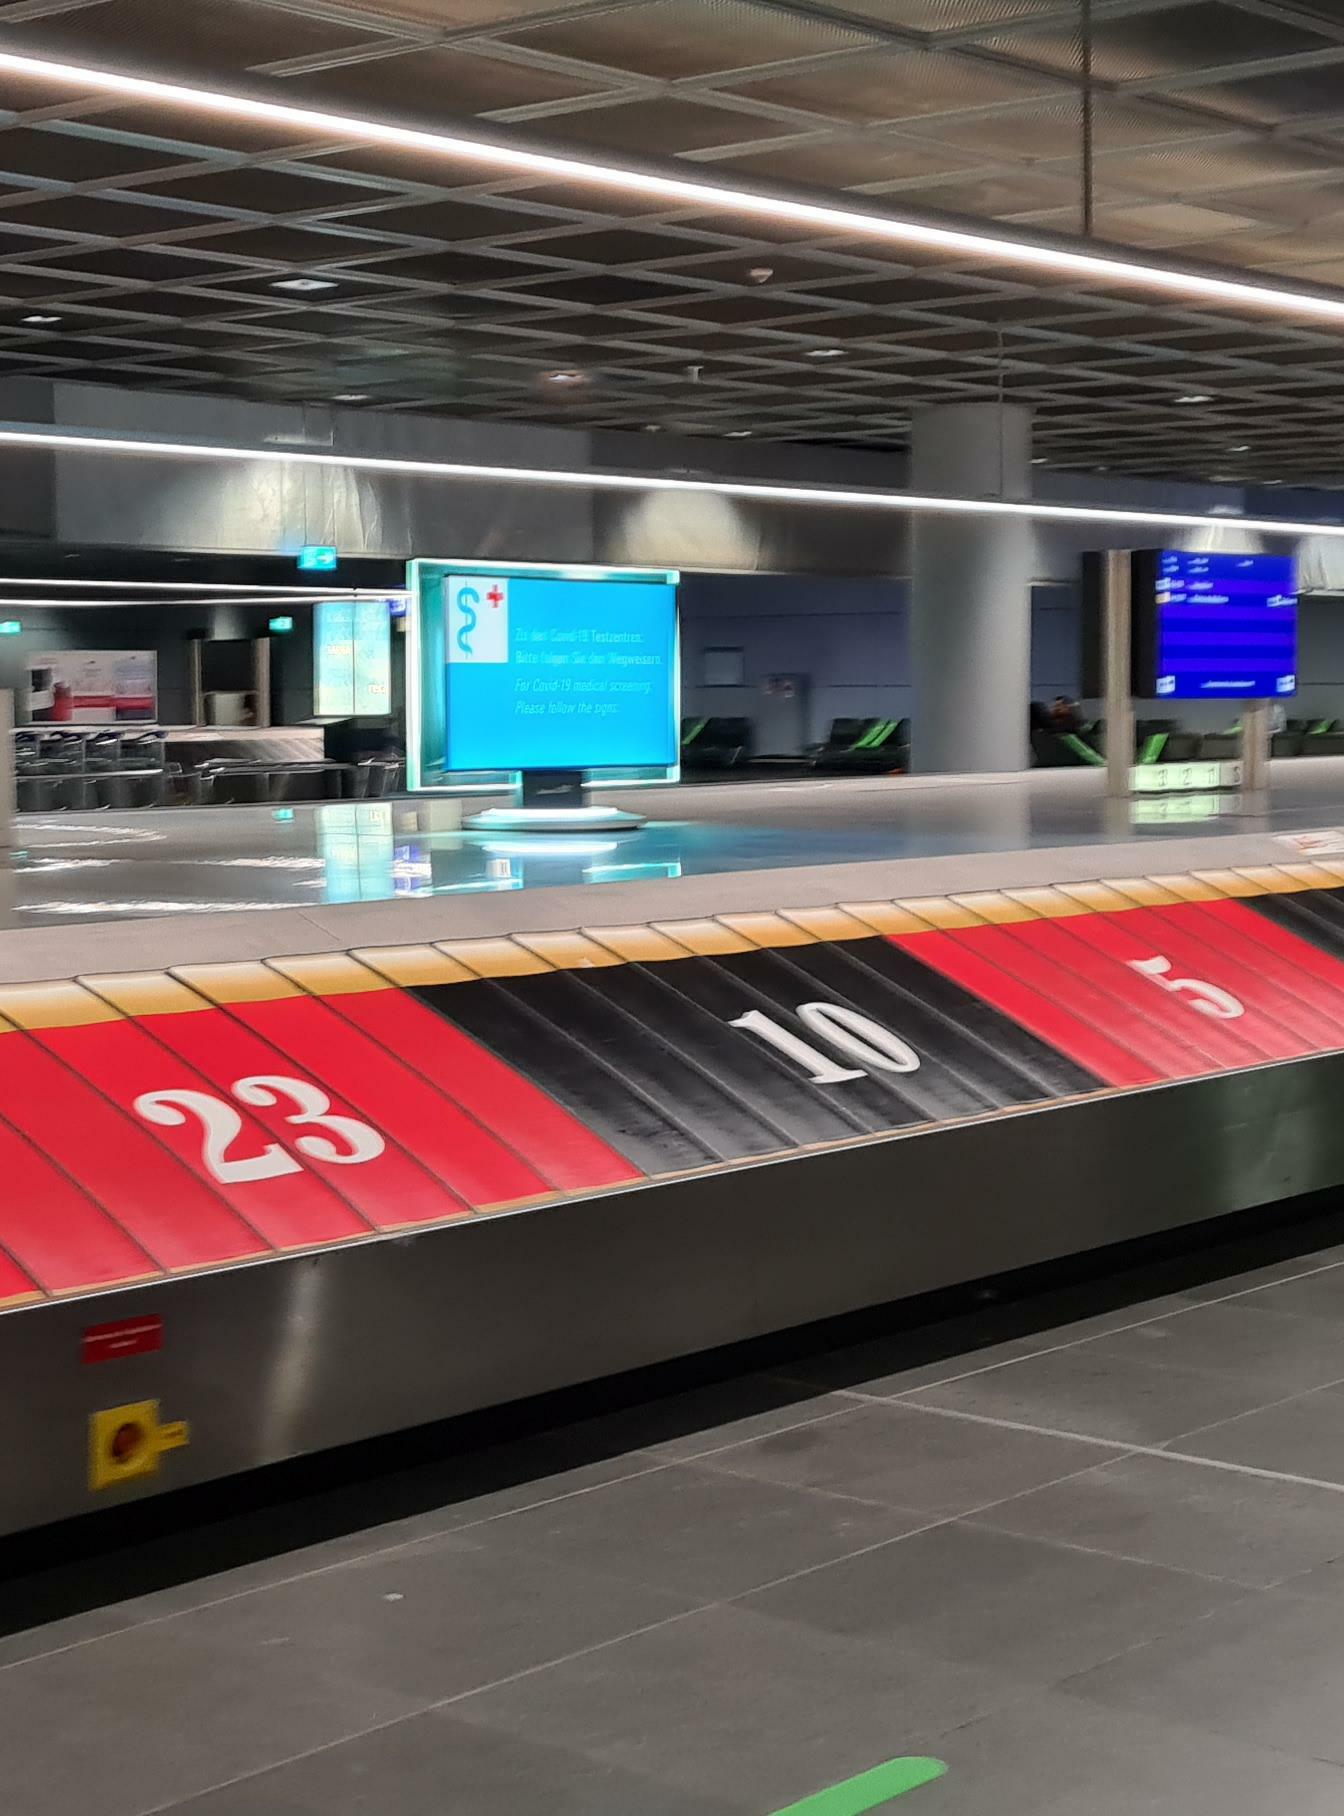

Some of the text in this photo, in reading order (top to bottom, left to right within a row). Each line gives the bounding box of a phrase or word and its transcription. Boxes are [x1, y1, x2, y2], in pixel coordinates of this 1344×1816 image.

[514, 701, 545, 714] Please
[548, 701, 576, 714] follow
[577, 701, 593, 714] the
[515, 678, 530, 692] For
[533, 678, 571, 692] Covid-19
[573, 679, 608, 692] medical
[1128, 955, 1246, 1020] 5
[727, 1001, 922, 1085] 10
[133, 1074, 387, 1185] 23
